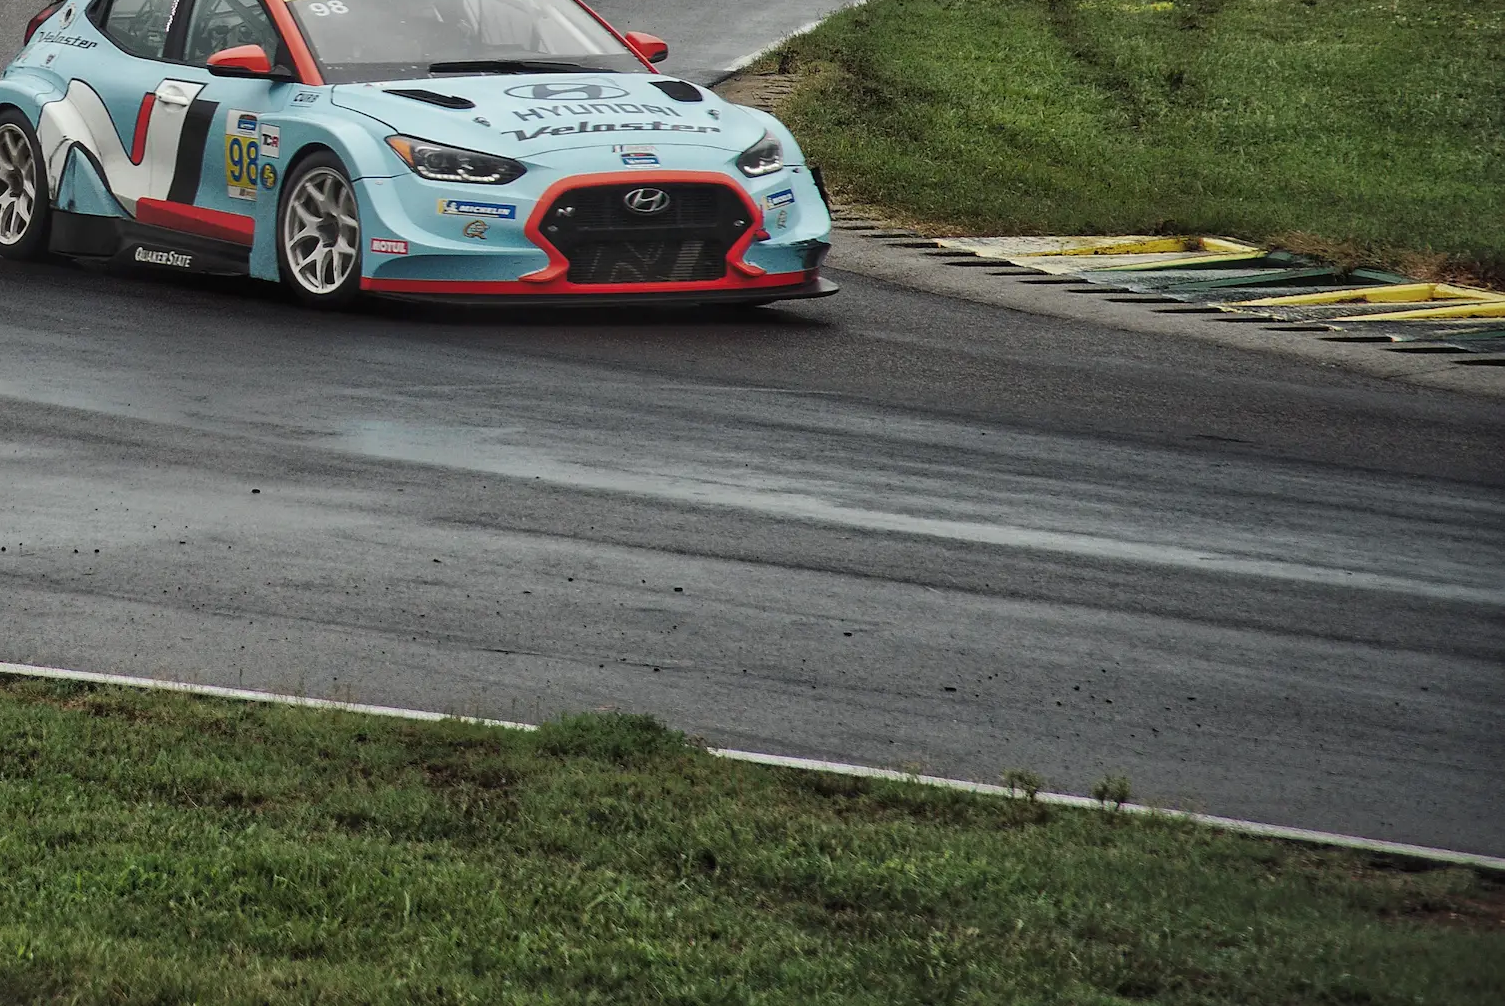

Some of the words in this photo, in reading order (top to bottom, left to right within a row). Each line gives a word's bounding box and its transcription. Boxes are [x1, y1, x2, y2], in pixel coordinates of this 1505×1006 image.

[308, 0, 350, 18] 98
[39, 31, 98, 49] Veloster
[512, 103, 683, 122] HYUNDAI
[501, 121, 722, 142] Veloster
[229, 137, 259, 186] 98
[458, 205, 511, 216] MICHELIN
[372, 240, 407, 253] MOTUL
